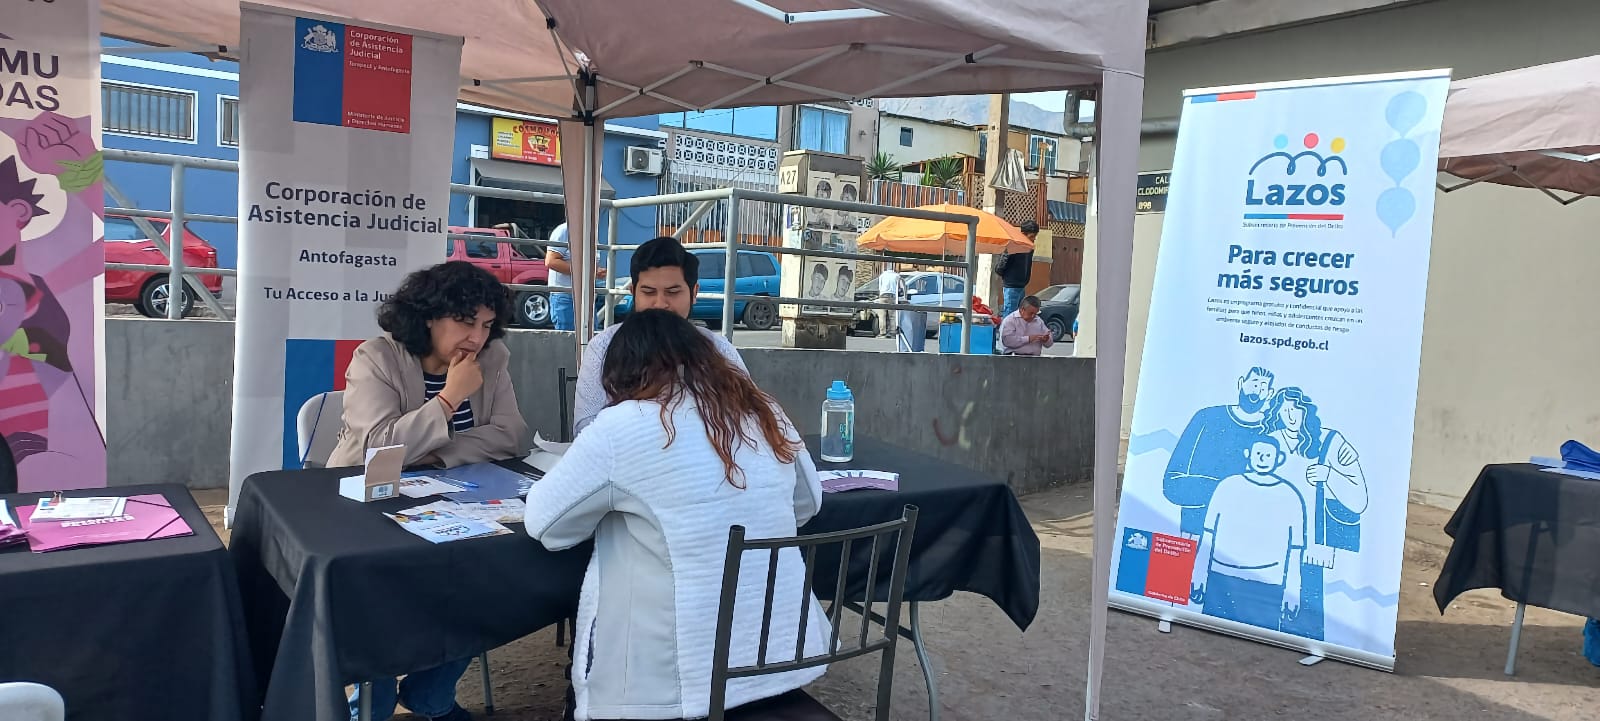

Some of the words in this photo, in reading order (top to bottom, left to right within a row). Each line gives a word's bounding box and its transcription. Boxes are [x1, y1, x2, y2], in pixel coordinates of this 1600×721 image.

[350, 30, 399, 44] Corporación
[350, 40, 361, 48] de
[362, 41, 404, 54] Asistencia
[350, 48, 381, 60] Judicial
[780, 169, 797, 185] A27
[1155, 176, 1169, 185] CAL
[265, 181, 396, 209] Corporación
[402, 193, 426, 210] de
[1245, 179, 1346, 206] Lazos
[248, 204, 361, 228] Asistencia
[366, 213, 442, 233] Judicial
[299, 249, 397, 267] Antofagasta
[1228, 244, 1277, 266] Para
[1283, 251, 1355, 269] crecer
[1217, 268, 1264, 290] más
[1269, 276, 1359, 299] seguros
[264, 286, 282, 299] Tu
[286, 287, 339, 301] Acceso
[342, 291, 351, 301] a
[355, 289, 368, 302] la
[372, 290, 396, 303] Jus
[1239, 332, 1329, 351] lazos.spd.gob.cl
